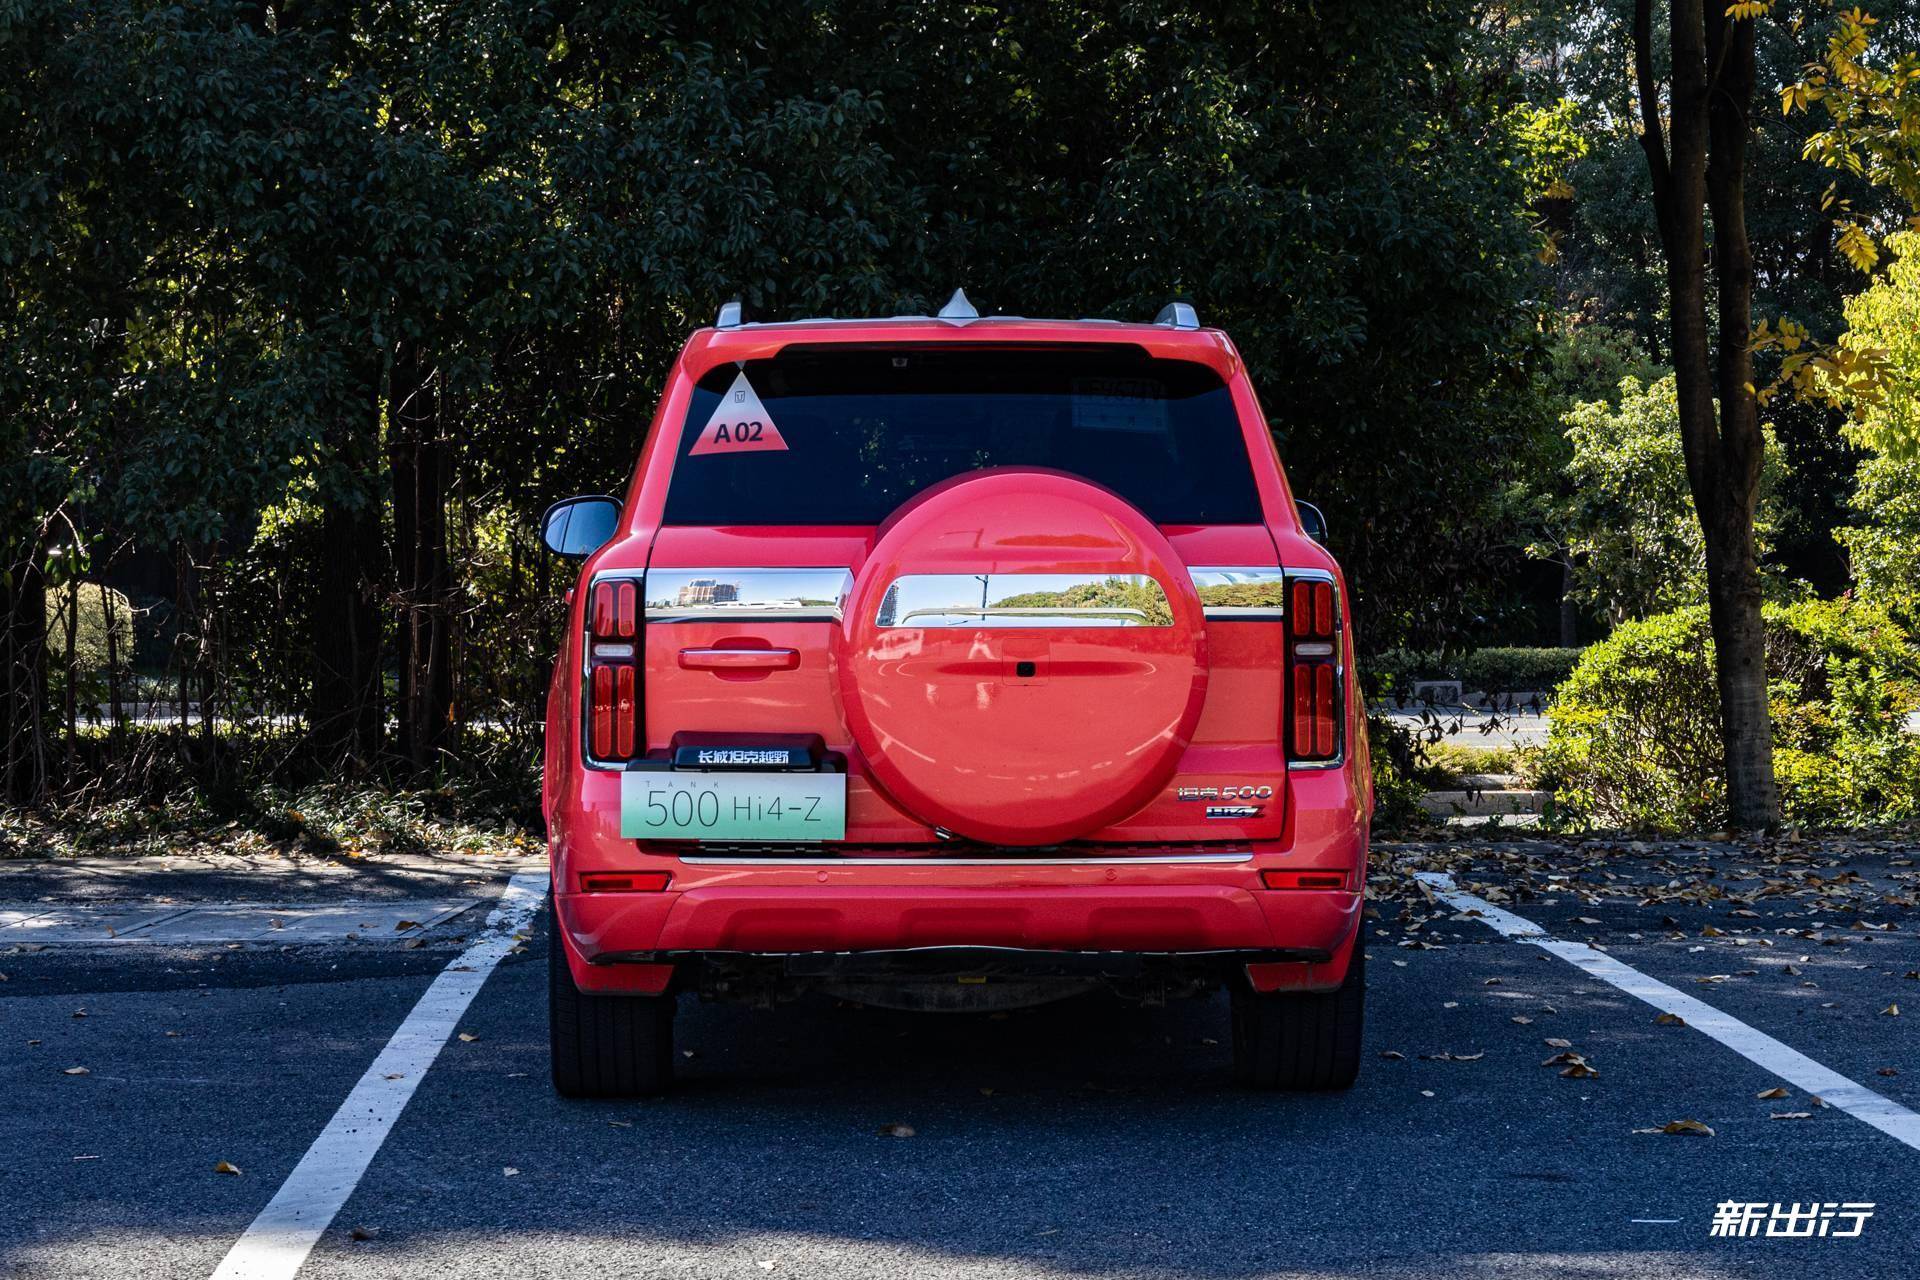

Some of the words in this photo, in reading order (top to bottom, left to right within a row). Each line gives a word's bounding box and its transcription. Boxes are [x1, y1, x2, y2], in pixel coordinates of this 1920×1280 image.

[697, 750, 789, 764] 长城坦克越野
[645, 780, 719, 788] TANK
[645, 790, 719, 827] 500
[733, 796, 822, 822] Hi4-Z
